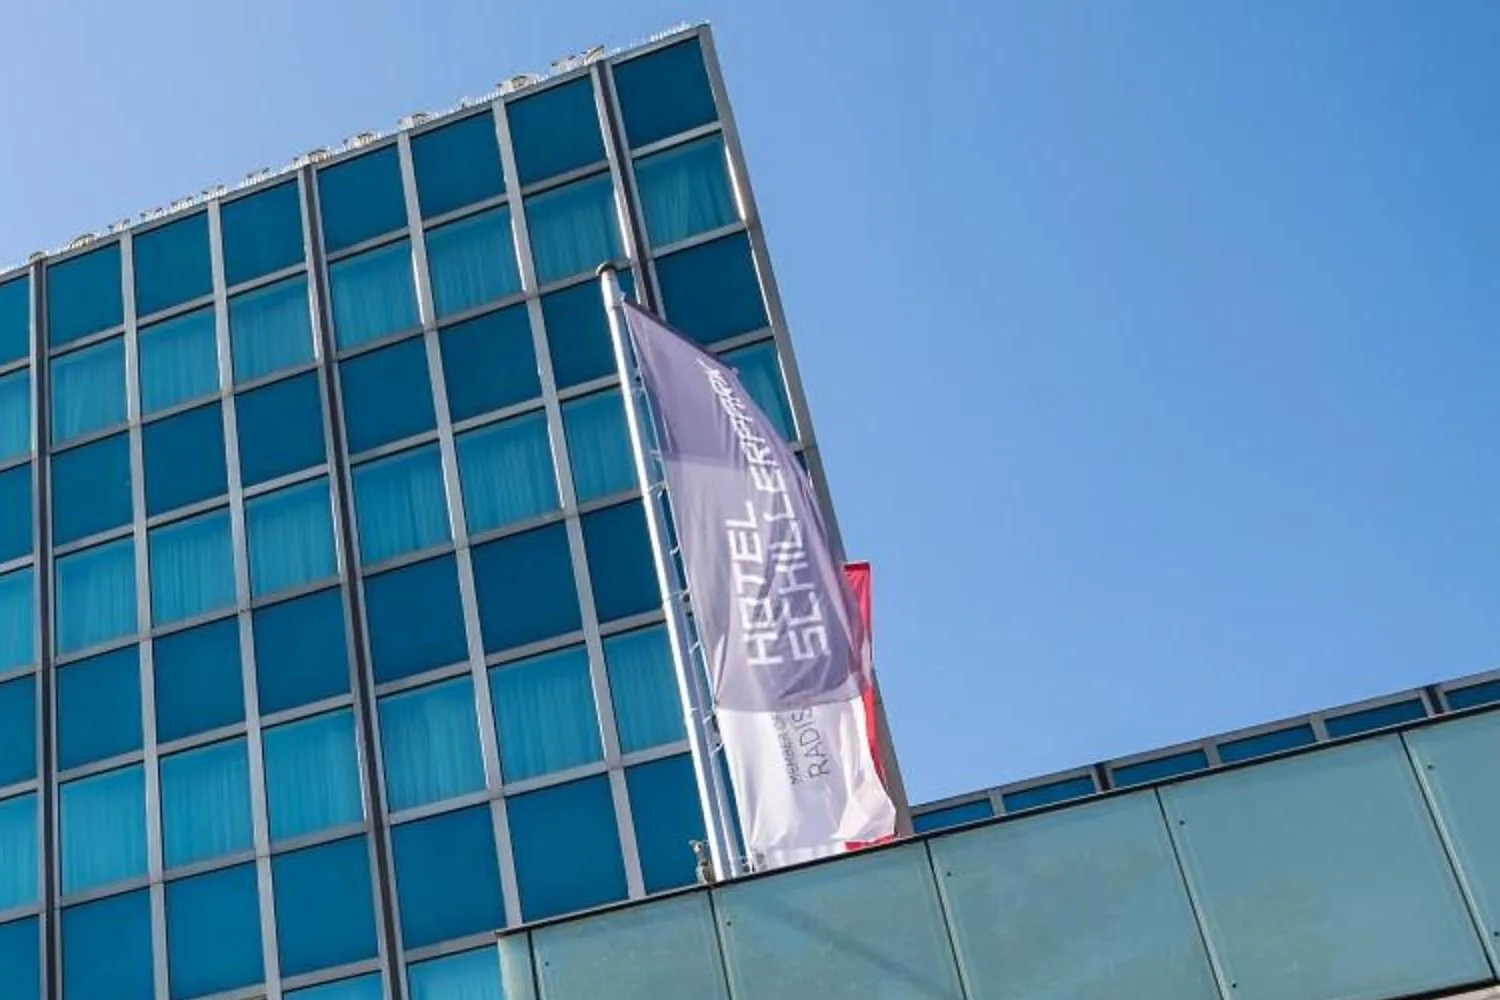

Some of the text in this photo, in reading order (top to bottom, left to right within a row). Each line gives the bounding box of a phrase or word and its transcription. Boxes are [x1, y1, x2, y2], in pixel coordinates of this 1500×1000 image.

[697, 357, 831, 660] SCHILLERPARK
[725, 500, 784, 664] HOTEL
[777, 733, 801, 784] MEMBER
